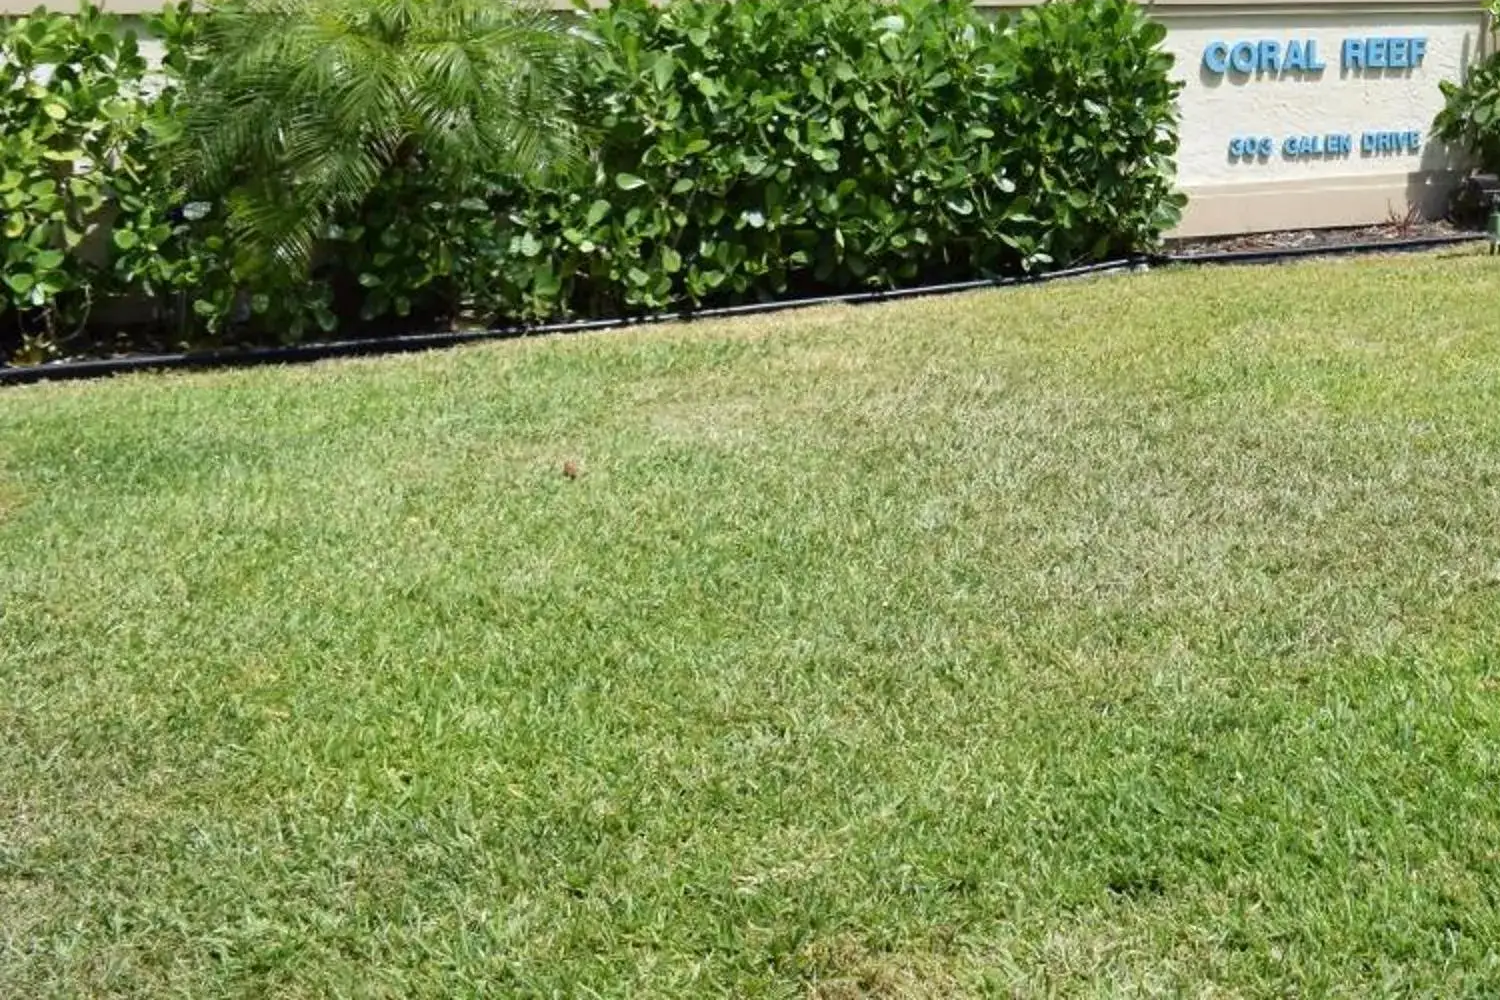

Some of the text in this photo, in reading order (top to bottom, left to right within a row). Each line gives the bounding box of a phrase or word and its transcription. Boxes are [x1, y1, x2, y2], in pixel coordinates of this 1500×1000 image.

[1203, 37, 1427, 73] CORAL REEF
[1361, 131, 1420, 152] DRIVE
